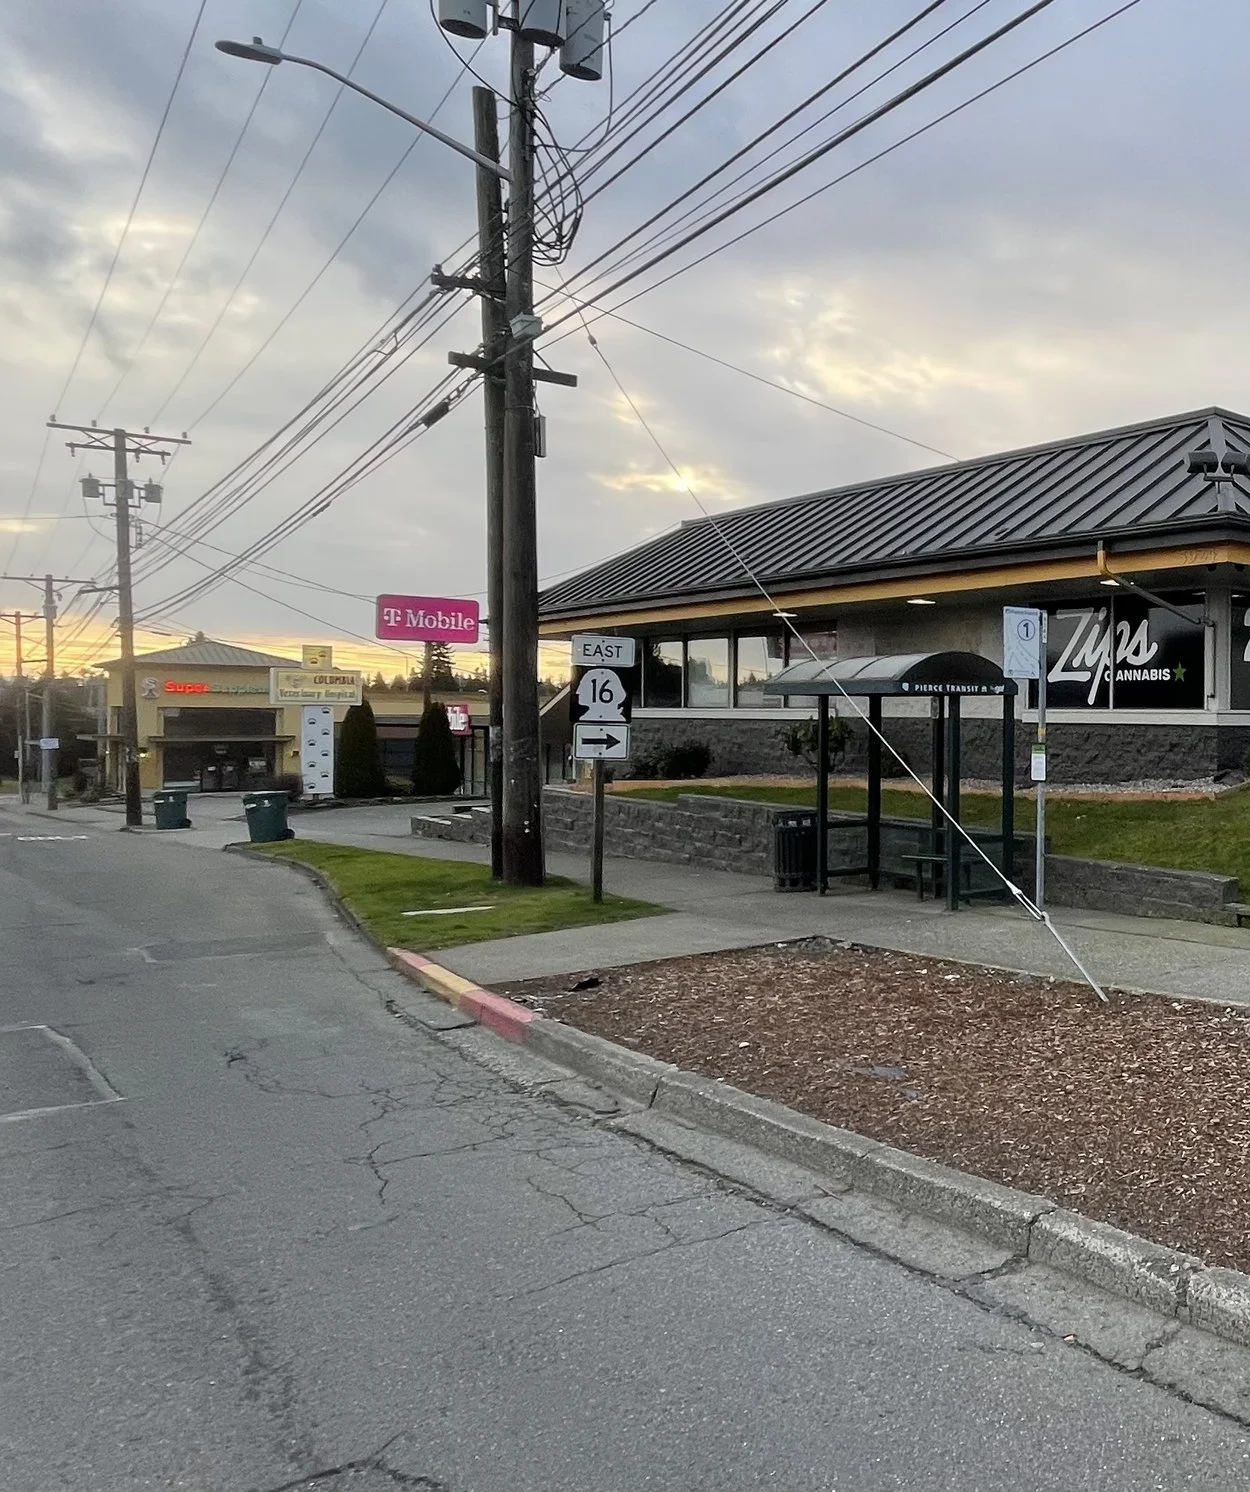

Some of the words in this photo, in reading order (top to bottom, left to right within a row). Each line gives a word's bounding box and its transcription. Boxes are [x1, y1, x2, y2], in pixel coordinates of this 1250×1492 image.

[404, 608, 475, 631] Mobile
[1022, 622, 1029, 638] 1
[583, 643, 623, 658] EAST
[1047, 606, 1158, 705] Zips
[313, 675, 355, 685] COLUMBIA
[1104, 667, 1171, 681] CANNABIS
[164, 680, 209, 694] Super
[591, 679, 613, 704] 16
[914, 684, 943, 692] PIERCE
[946, 684, 979, 693] TRANSIT
